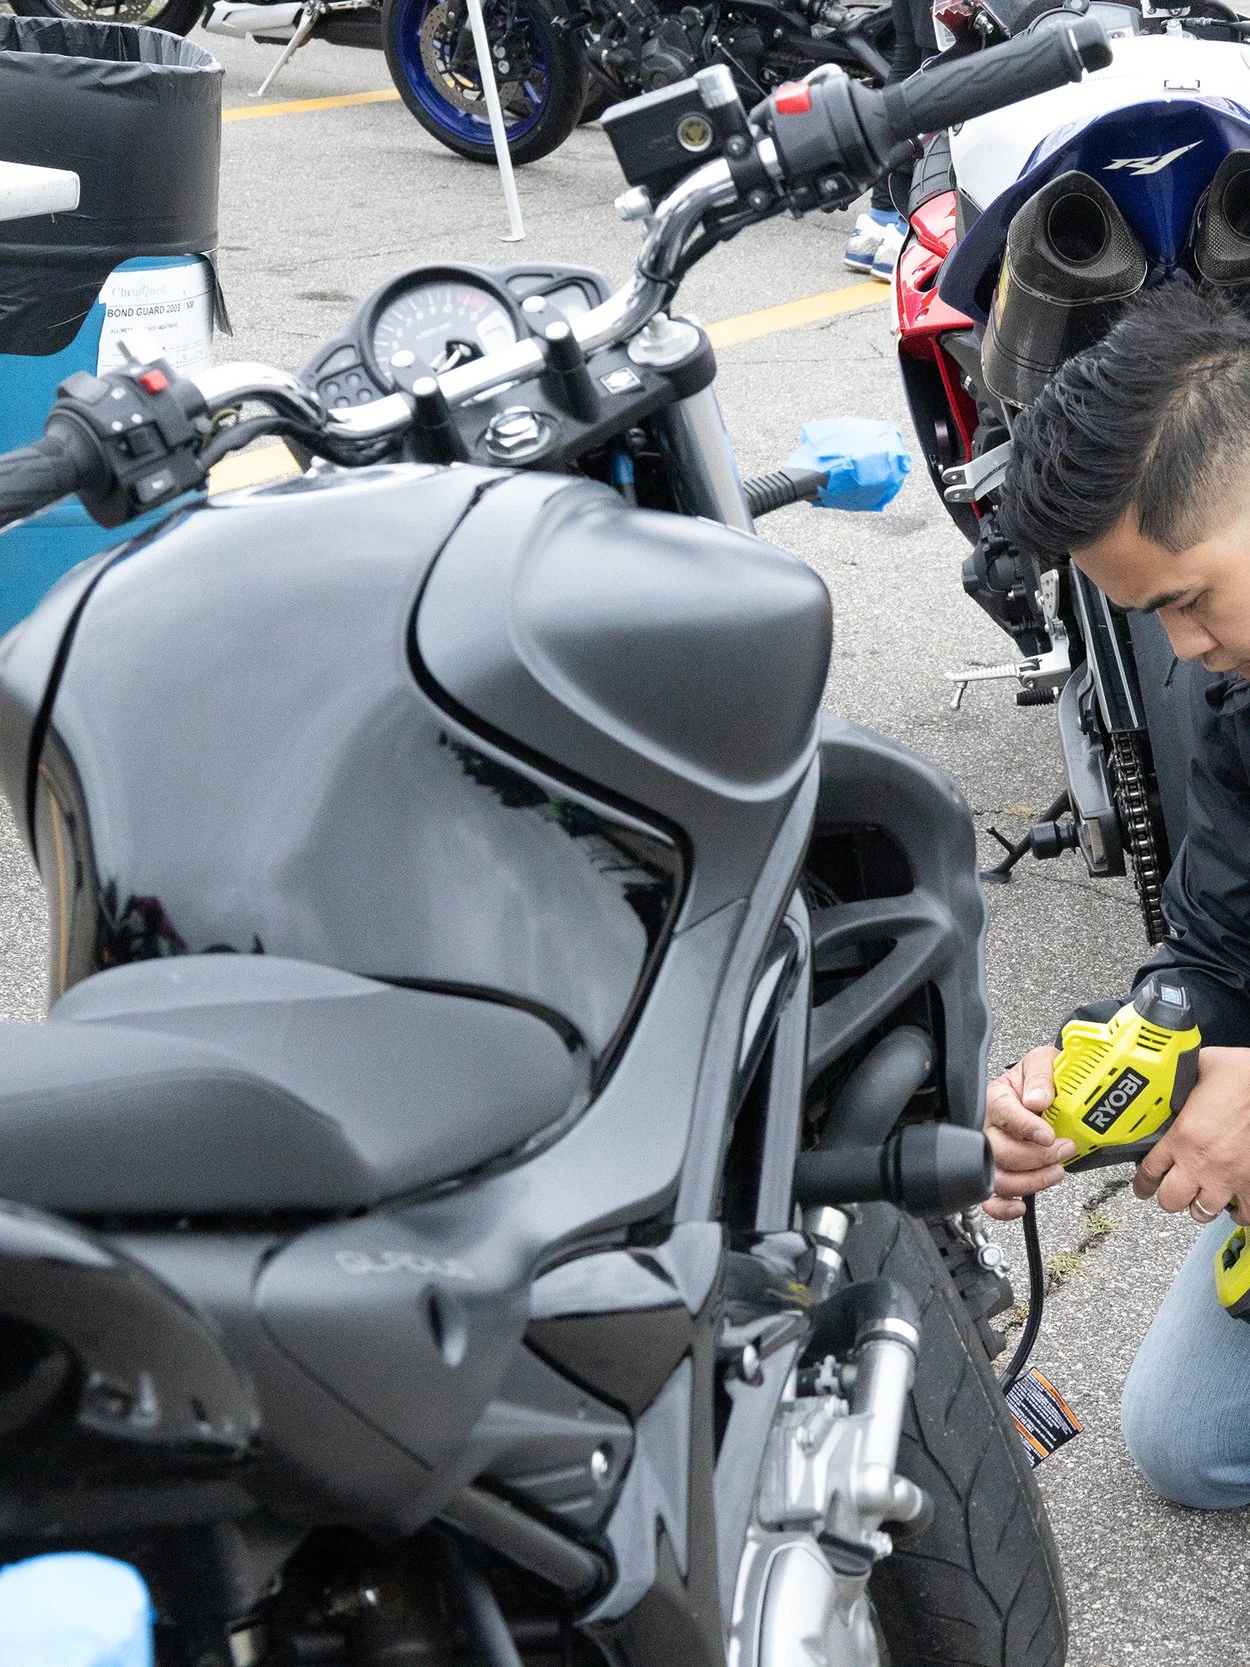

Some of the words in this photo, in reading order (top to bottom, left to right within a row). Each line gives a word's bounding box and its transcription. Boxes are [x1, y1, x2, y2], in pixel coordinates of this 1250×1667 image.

[107, 308, 134, 318] BOND
[136, 305, 165, 316] GUARD
[1088, 1073, 1143, 1128] RYOBI
